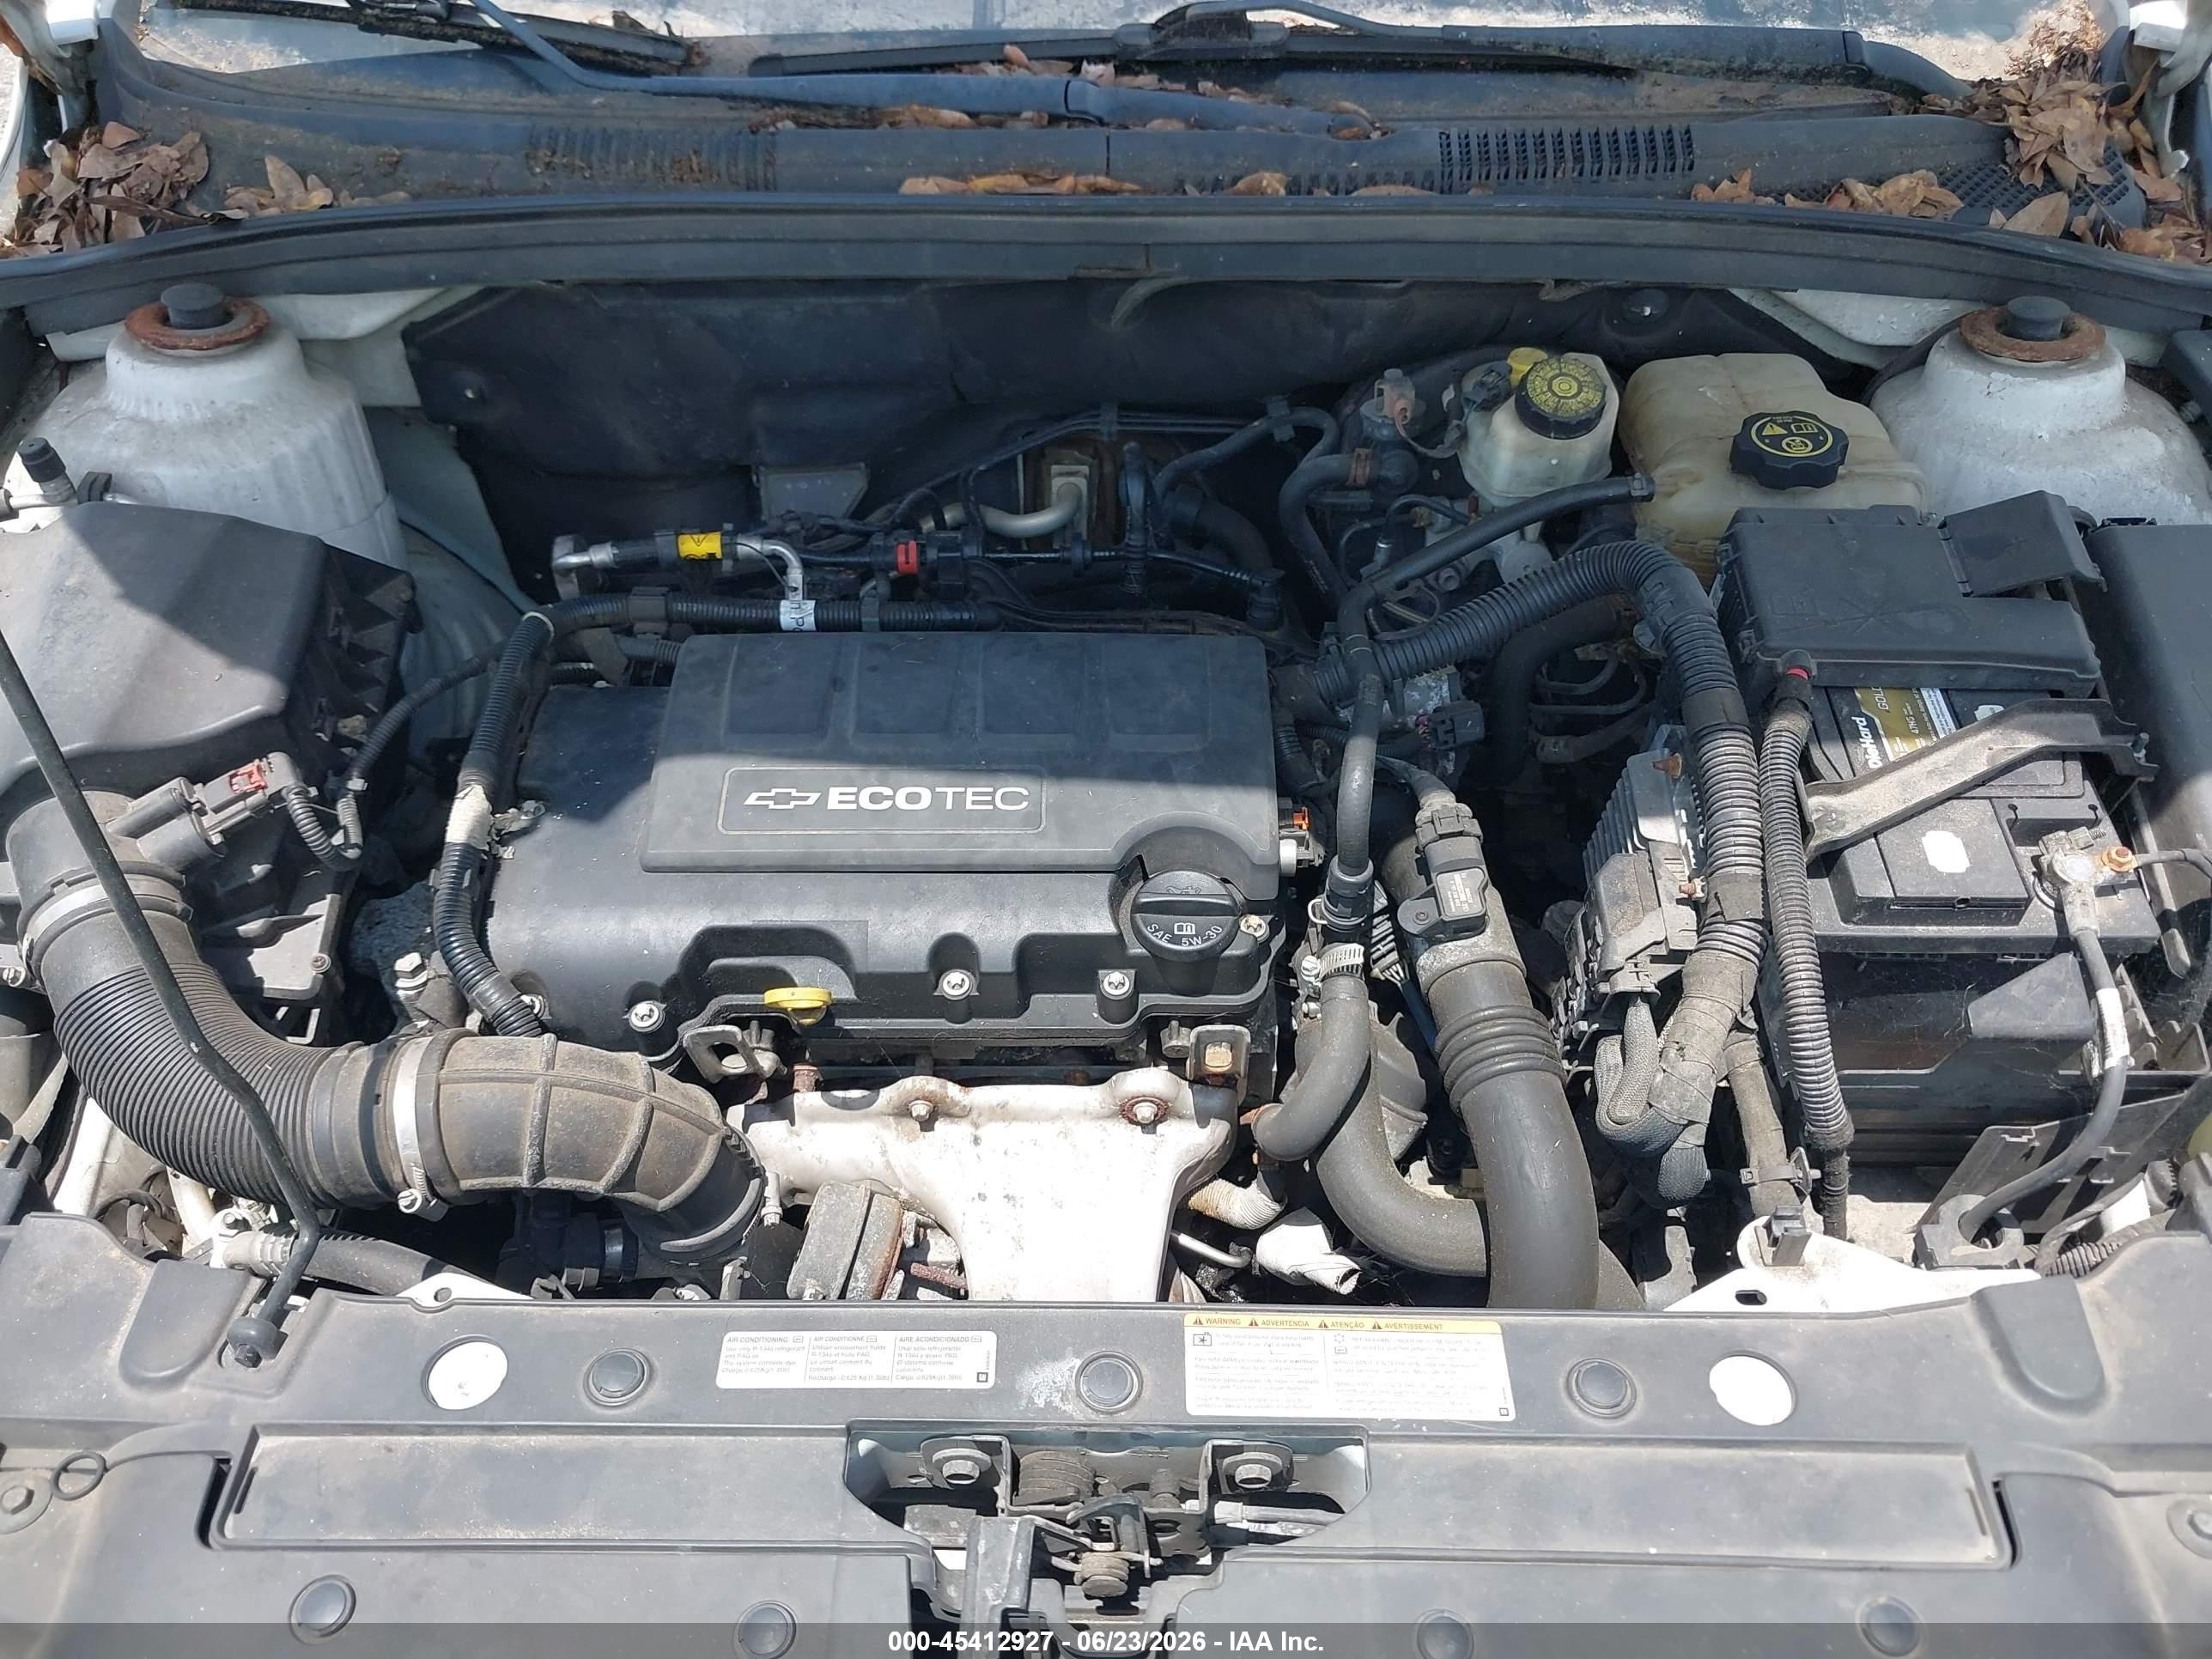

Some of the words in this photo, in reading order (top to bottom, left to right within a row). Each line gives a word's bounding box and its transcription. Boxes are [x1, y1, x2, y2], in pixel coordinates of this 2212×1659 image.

[1851, 715, 1883, 769] DieHard
[827, 787, 1030, 811] ECOTEC
[1146, 922, 1172, 943] SAE
[1181, 925, 1223, 947] 5W-30
[1205, 1316, 1242, 1326] WARNING
[1261, 1319, 1310, 1328] ADVERTENCIA
[1383, 1322, 1443, 1331] AVERTISSEMENT
